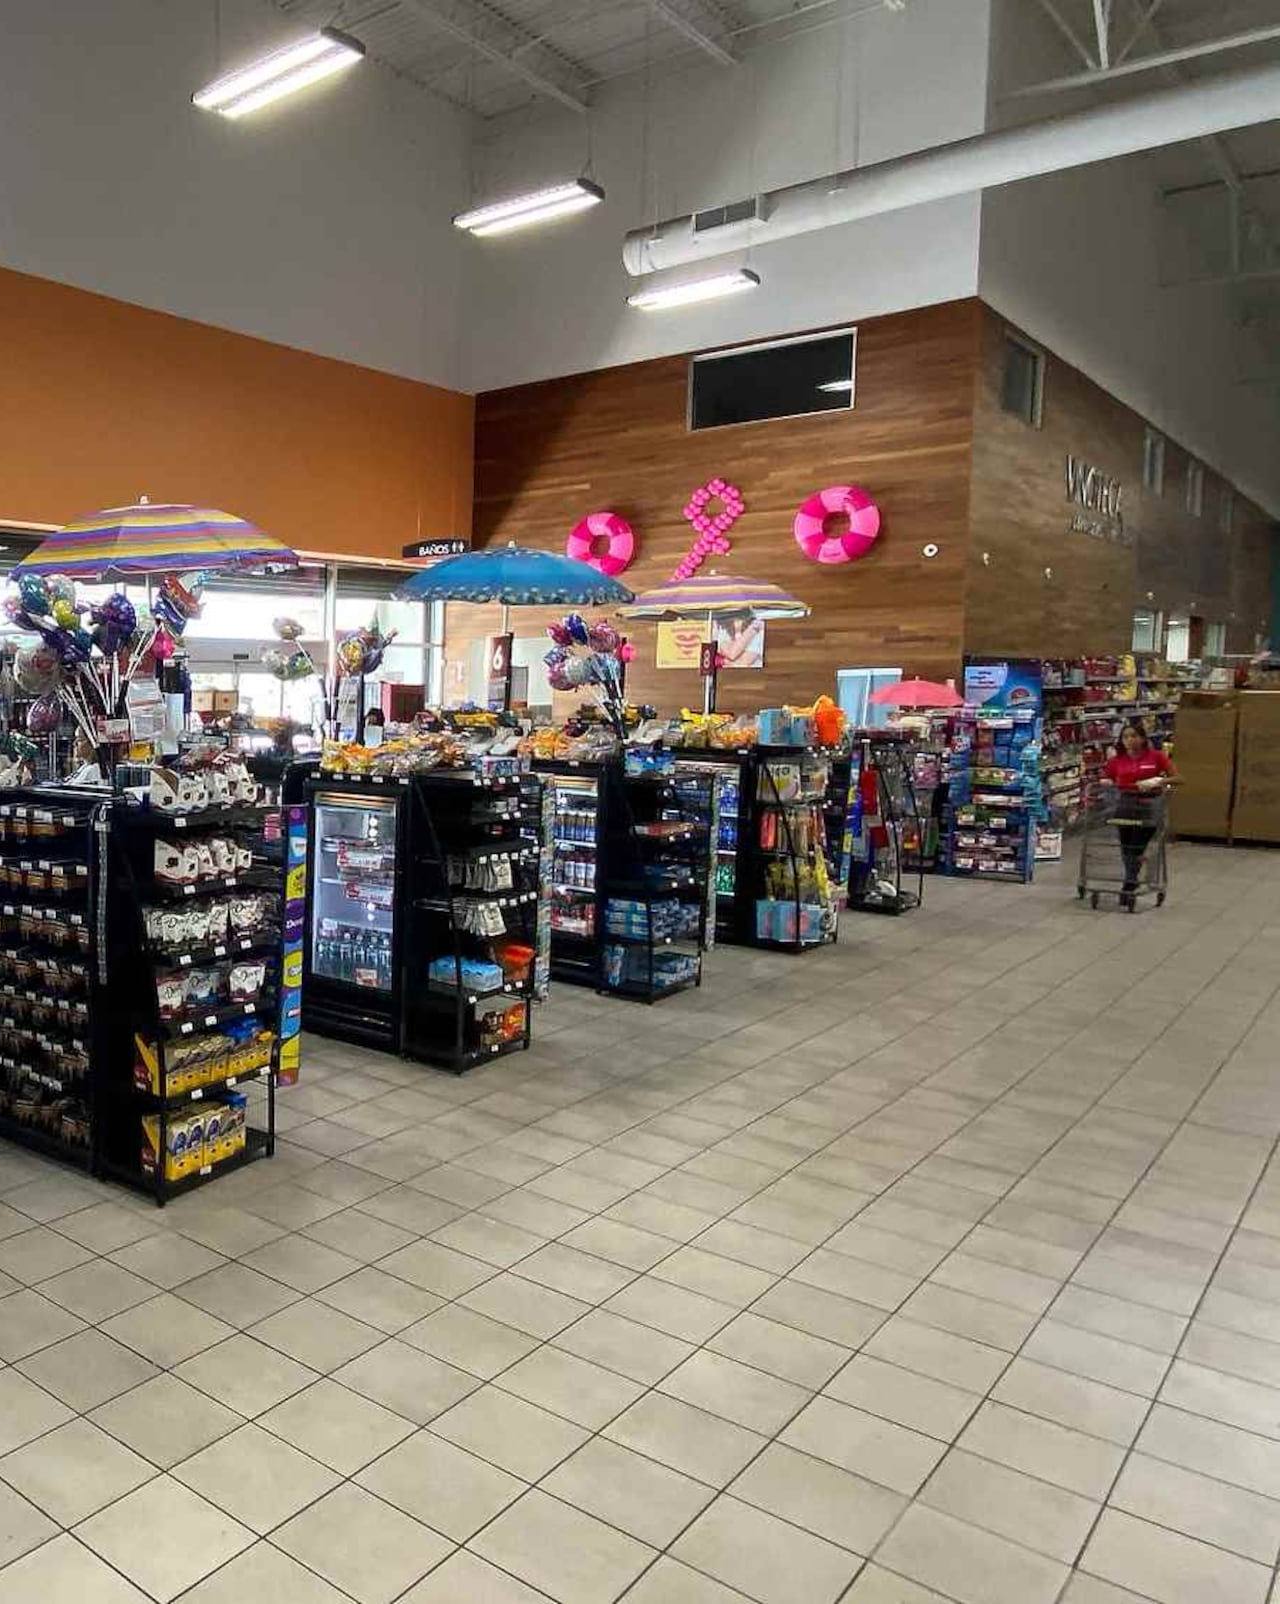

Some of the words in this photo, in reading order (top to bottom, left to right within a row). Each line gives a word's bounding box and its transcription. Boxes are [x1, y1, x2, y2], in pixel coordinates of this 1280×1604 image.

[419, 544, 449, 556] BAÑOS
[493, 645, 503, 670] 6
[703, 649, 711, 669] 8
